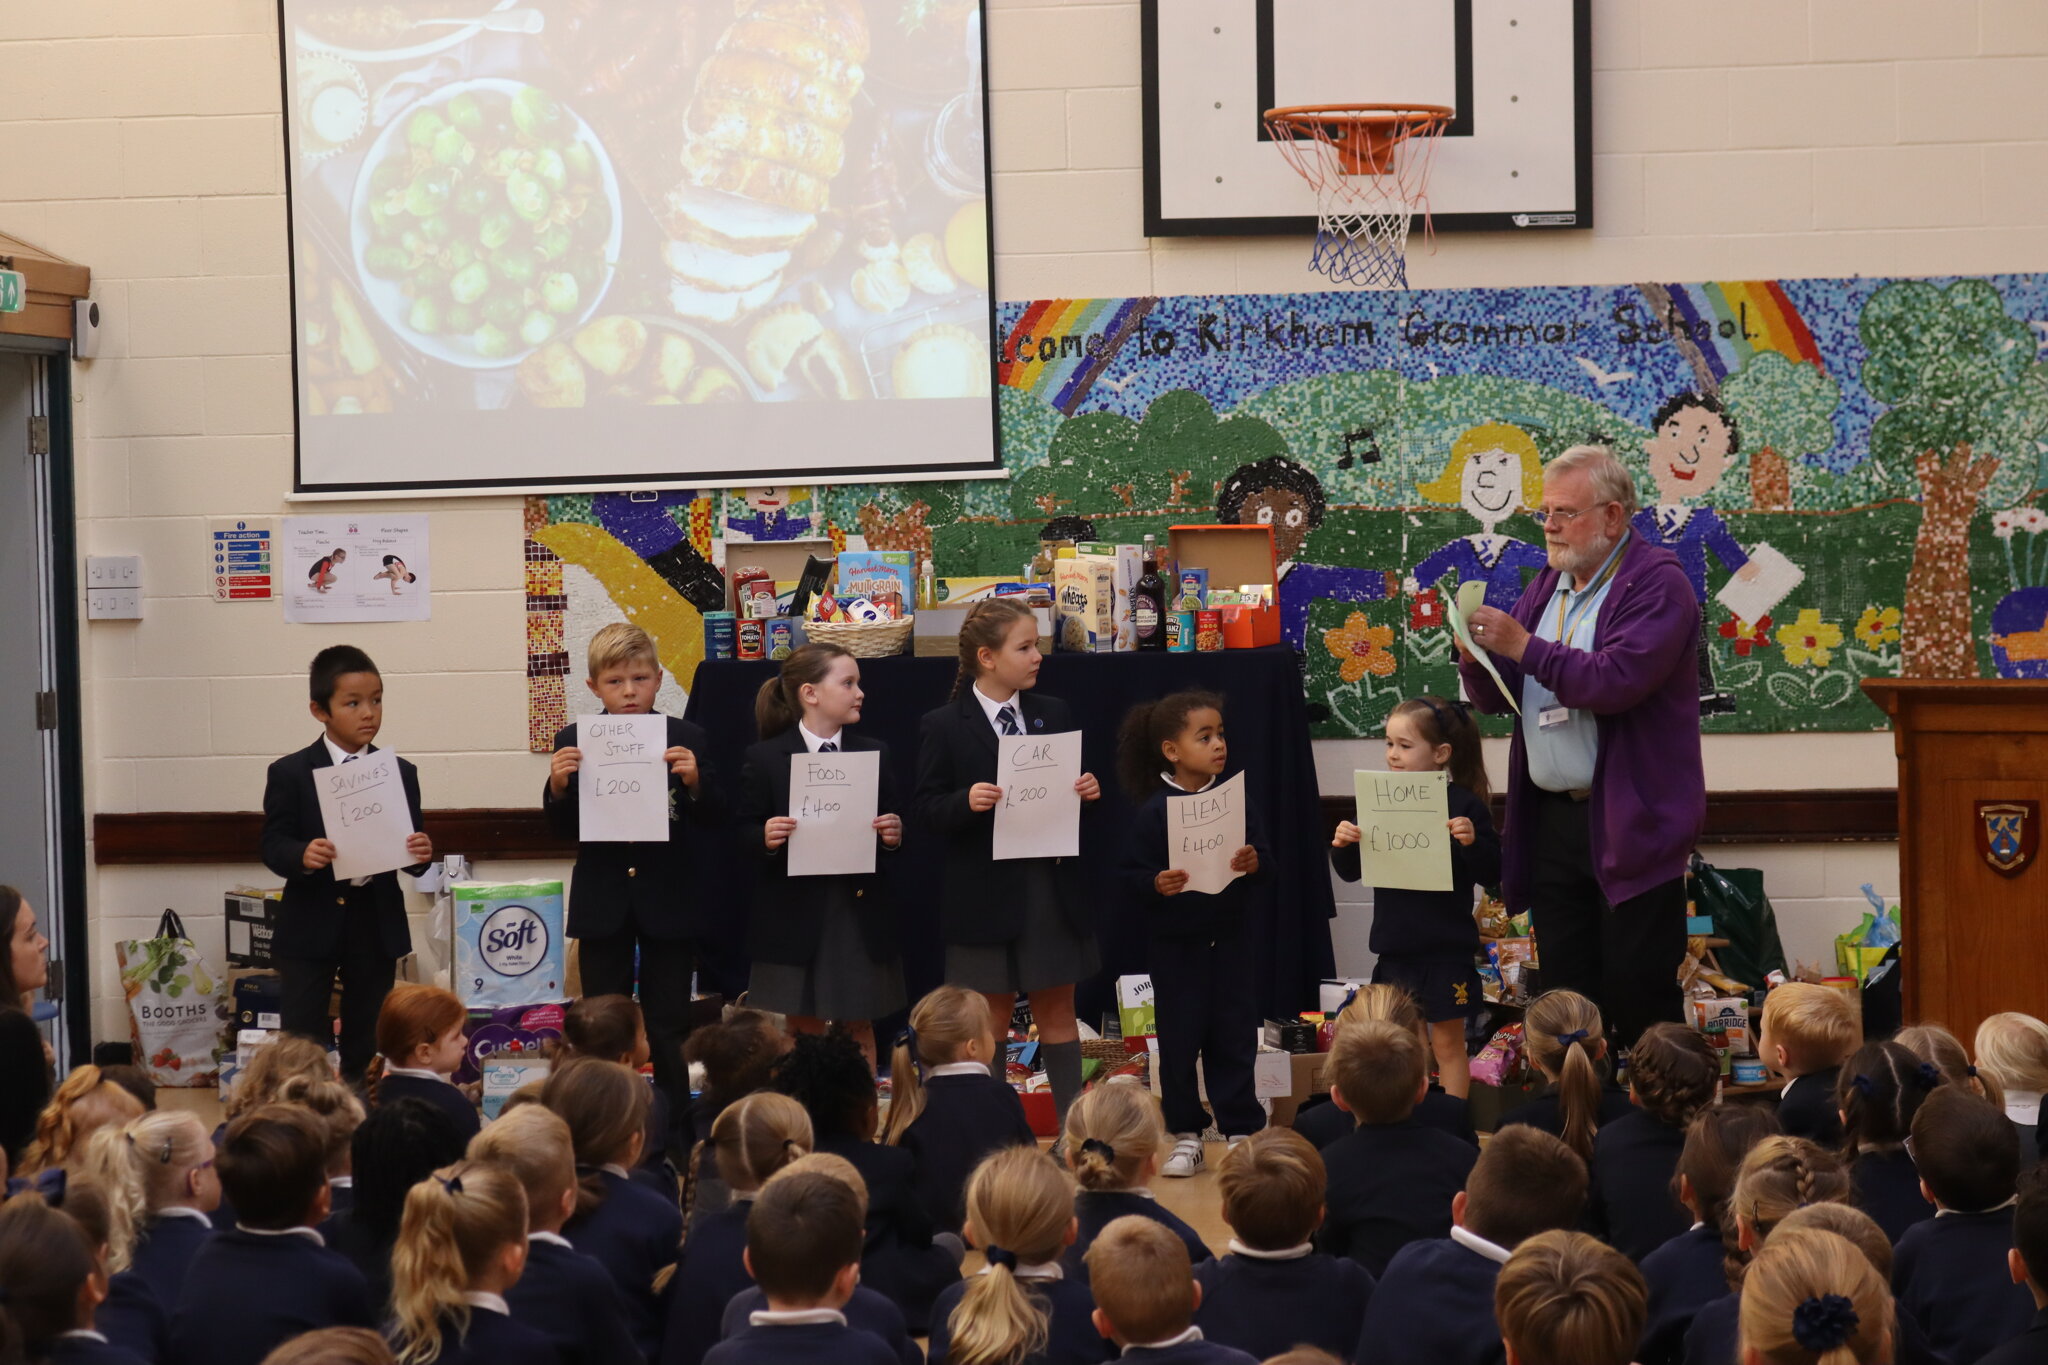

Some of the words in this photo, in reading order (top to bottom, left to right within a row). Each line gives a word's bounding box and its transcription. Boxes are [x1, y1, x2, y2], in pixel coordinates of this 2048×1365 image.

[1135, 313, 1176, 358] to
[1199, 310, 1374, 352] Kirkham
[1405, 309, 1588, 347] Grammar
[846, 578, 901, 593] MULTIGRAIN
[1061, 585, 1088, 606] wheats
[1129, 587, 1137, 622] Cheerios
[742, 624, 759, 632] HEINZ
[590, 722, 636, 738] OTHER
[604, 741, 646, 756] STUFF
[1012, 743, 1054, 767] CAR
[330, 762, 389, 794] SAVINGS
[807, 762, 846, 783] FOOD
[1374, 778, 1431, 806] HOME
[1181, 787, 1232, 825] HEAT
[1369, 825, 1430, 853] £1000
[474, 977, 484, 990] 9
[141, 1003, 207, 1019] BOOTHS
